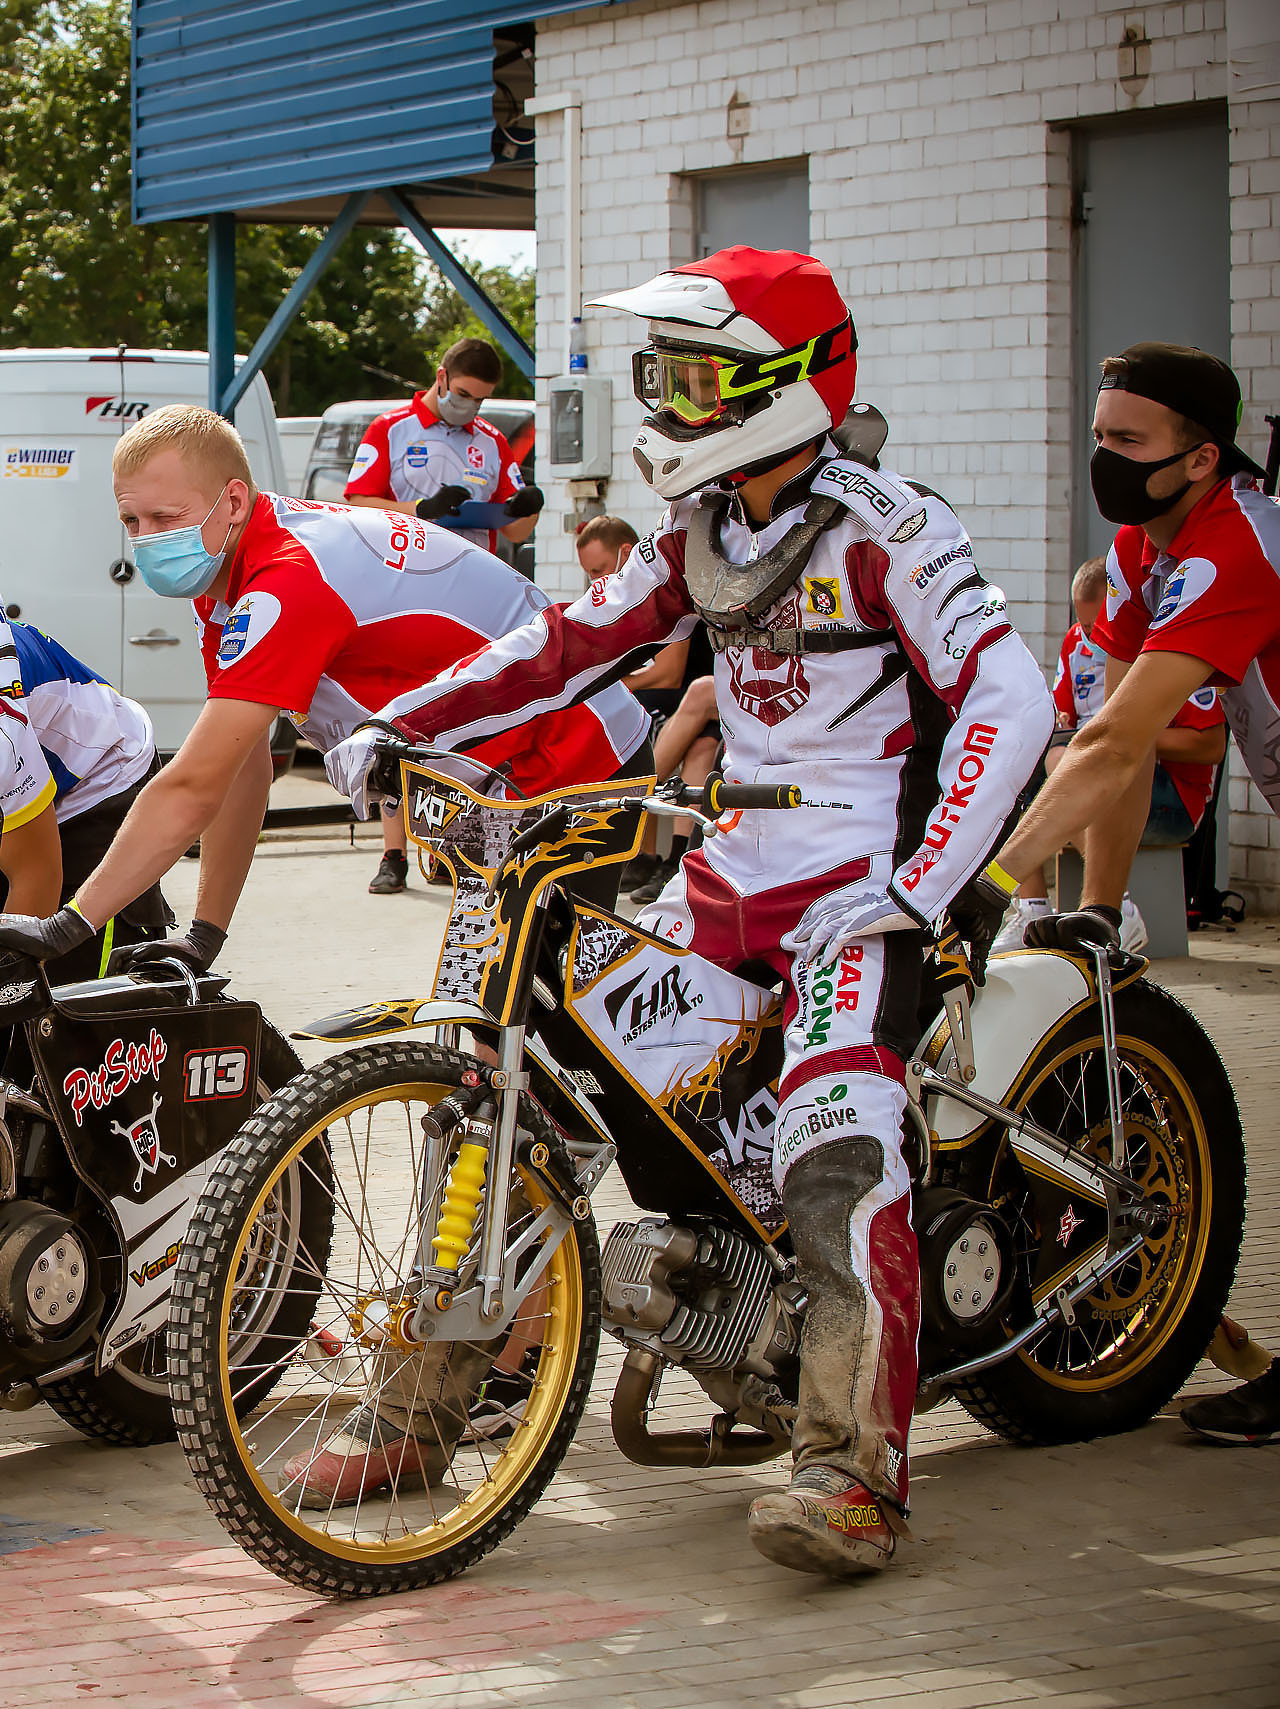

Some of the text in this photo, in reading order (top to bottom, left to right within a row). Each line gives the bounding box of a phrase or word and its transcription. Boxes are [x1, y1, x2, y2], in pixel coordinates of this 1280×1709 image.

[665, 920, 683, 940] TO
[690, 993, 704, 1009] TO
[803, 950, 839, 1052] RONA
[834, 945, 864, 1015] BAR
[621, 999, 676, 1047] FASTEST WAY
[63, 1027, 168, 1128] PitStop
[187, 1052, 246, 1098] 113
[776, 1106, 859, 1166] GreenBūve
